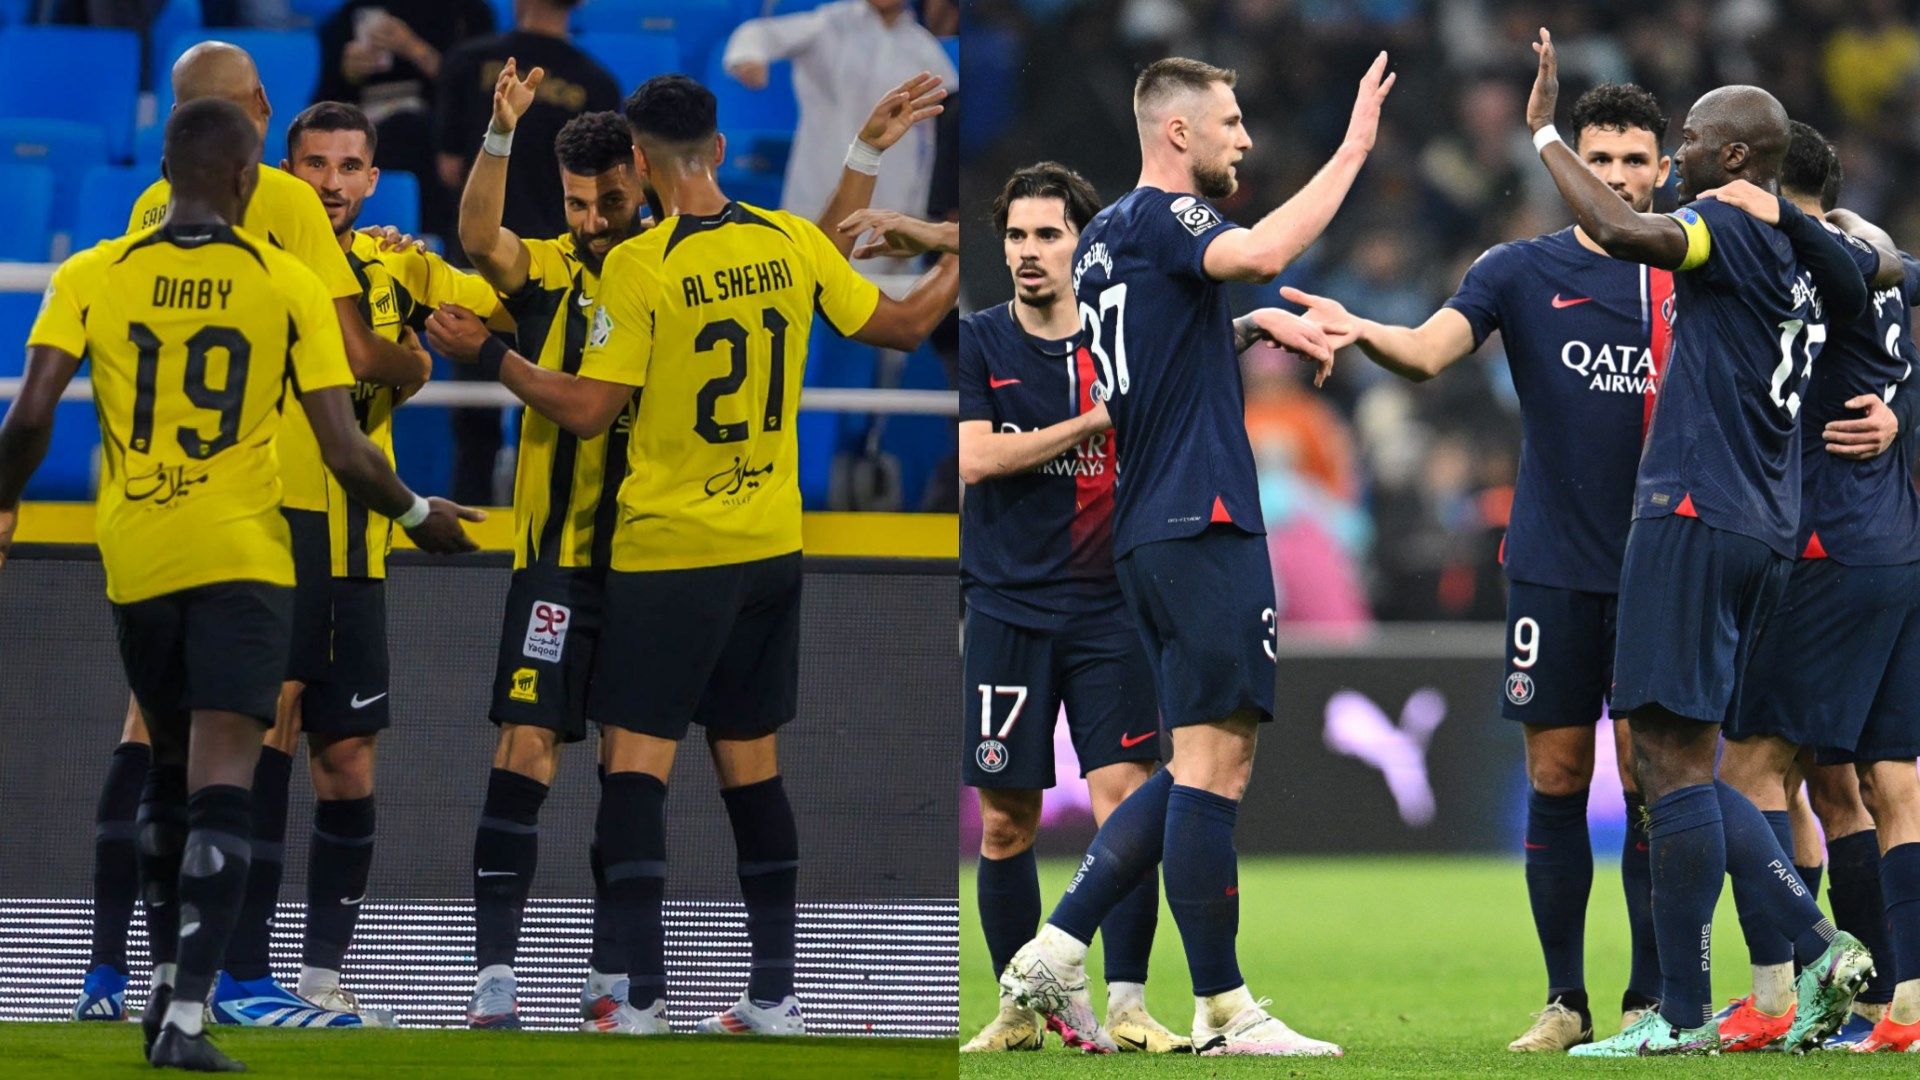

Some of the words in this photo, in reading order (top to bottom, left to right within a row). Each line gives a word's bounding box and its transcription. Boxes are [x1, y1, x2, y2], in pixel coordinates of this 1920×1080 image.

[152, 275, 233, 310] DIABY
[682, 274, 714, 308] AL
[714, 258, 793, 301] SHEHRI
[1078, 282, 1131, 402] 37
[1561, 340, 1659, 377] QATA
[128, 320, 253, 461] 19
[693, 306, 790, 444] 21
[1589, 373, 1659, 395] AIRWA
[528, 643, 558, 658] Yaqoot
[1512, 616, 1540, 669] 9
[978, 684, 1028, 739] 17
[1066, 854, 1095, 894] PARIS
[1767, 859, 1806, 897] PARIS
[1701, 923, 1711, 972] PARIS
